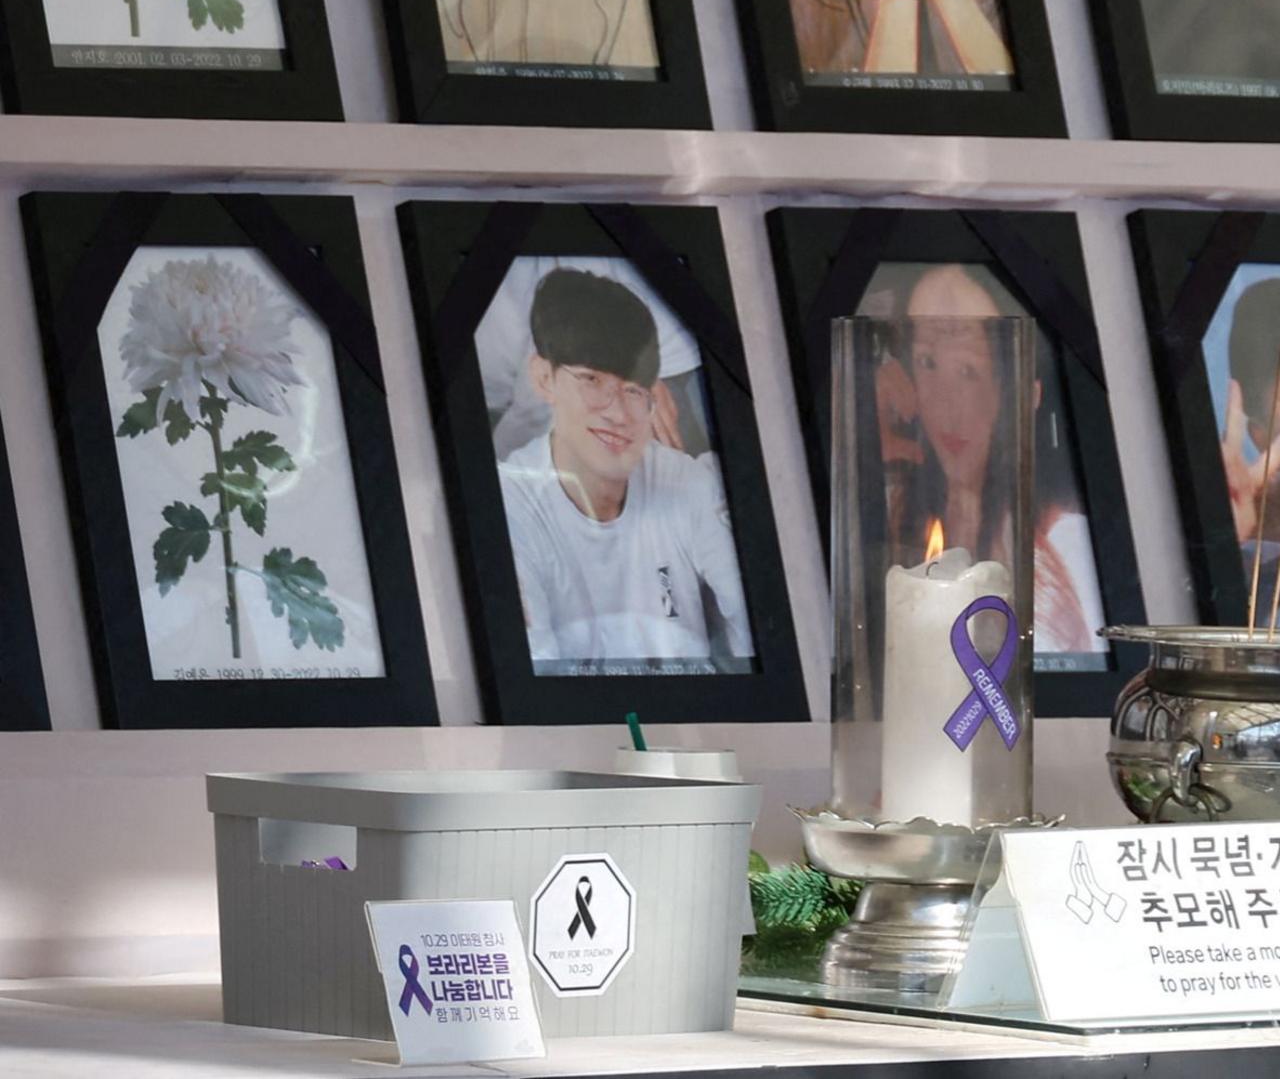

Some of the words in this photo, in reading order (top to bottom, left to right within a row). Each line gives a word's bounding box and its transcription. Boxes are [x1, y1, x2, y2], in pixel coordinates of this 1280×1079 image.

[973, 668, 1016, 739] REMEMBER
[1117, 837, 1182, 881] 잠시
[1141, 889, 1240, 932] 추모해
[451, 932, 482, 947] 이태원
[483, 932, 504, 947] 참사
[427, 953, 510, 975] 보라리본을
[567, 949, 581, 958] FOR
[1149, 945, 1204, 964] Please
[1207, 943, 1243, 962] take
[1247, 949, 1256, 961] a
[569, 963, 593, 976] 10.29
[431, 979, 513, 1001] 나눔합니다
[1160, 975, 1177, 993] to
[1180, 976, 1216, 997] pray
[1219, 972, 1241, 991] for
[1245, 972, 1272, 990] the
